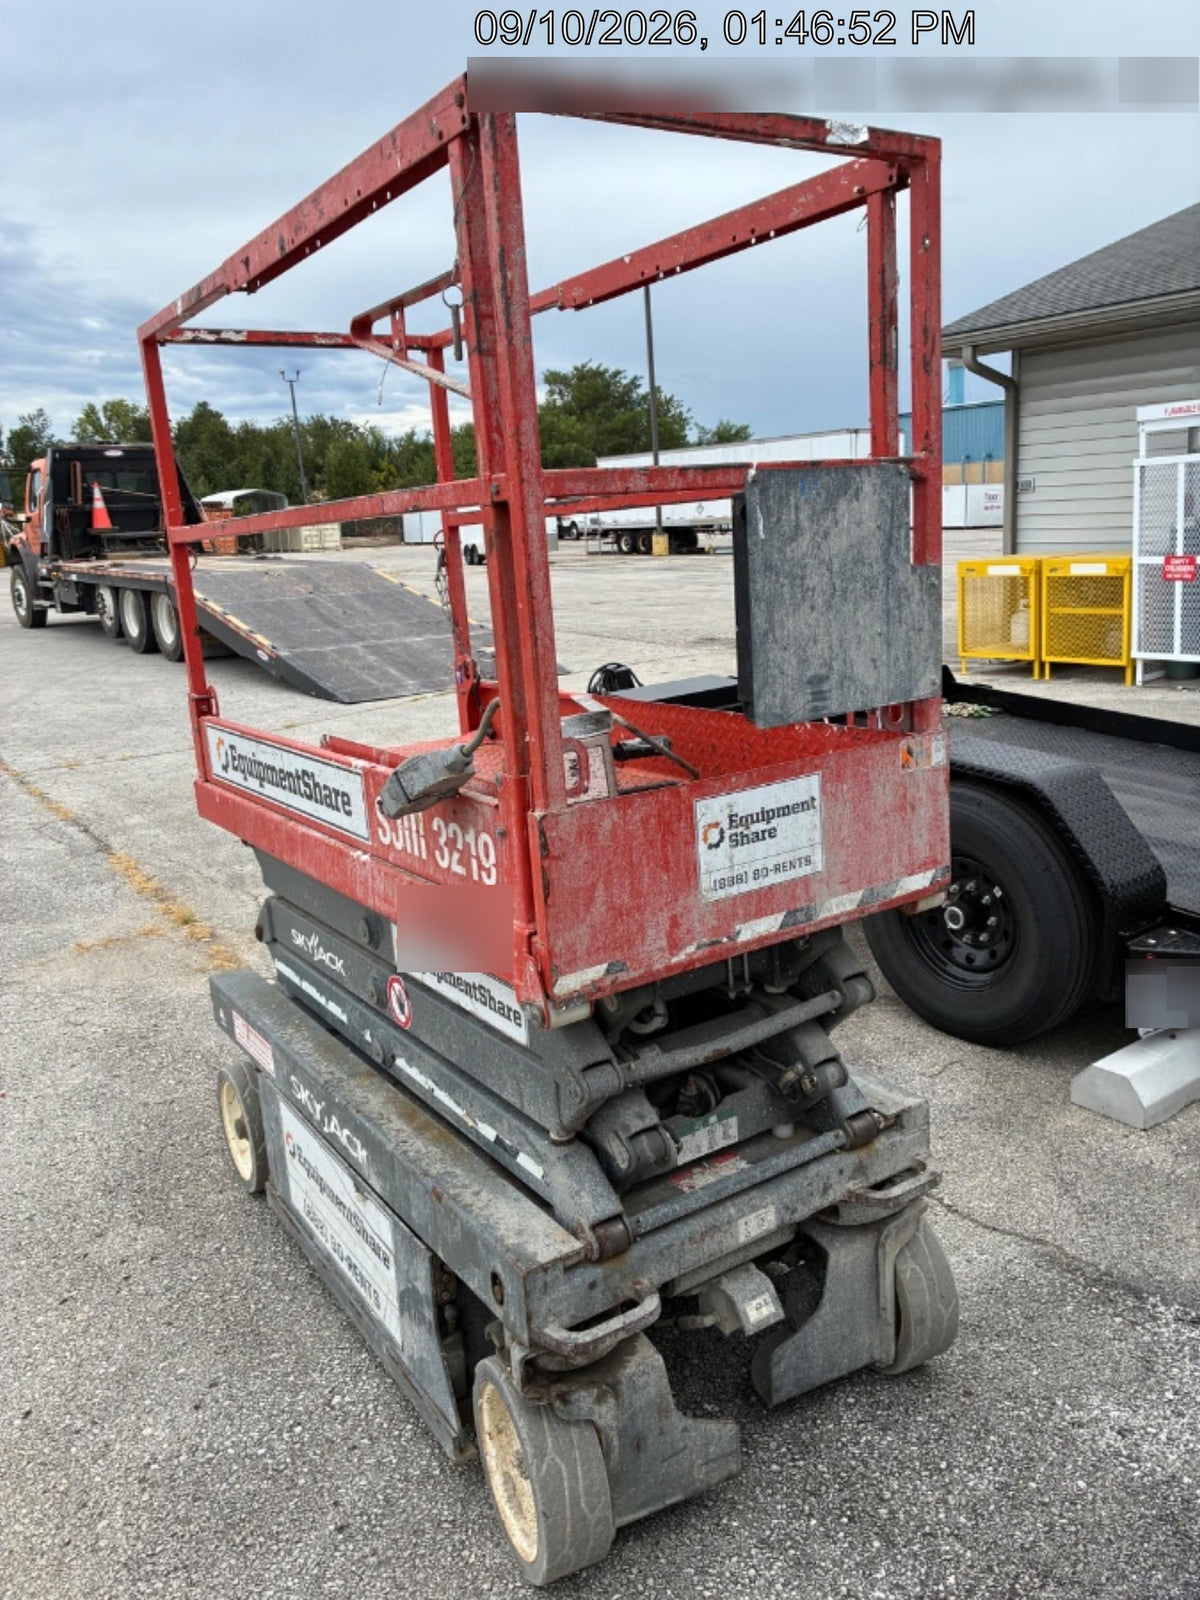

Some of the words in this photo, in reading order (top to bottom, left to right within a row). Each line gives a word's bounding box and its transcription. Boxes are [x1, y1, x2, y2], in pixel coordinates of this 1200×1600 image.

[229, 744, 352, 816] EquipmentShare
[728, 796, 817, 829] Equipment
[728, 826, 777, 848] Share
[432, 817, 497, 885] 3219
